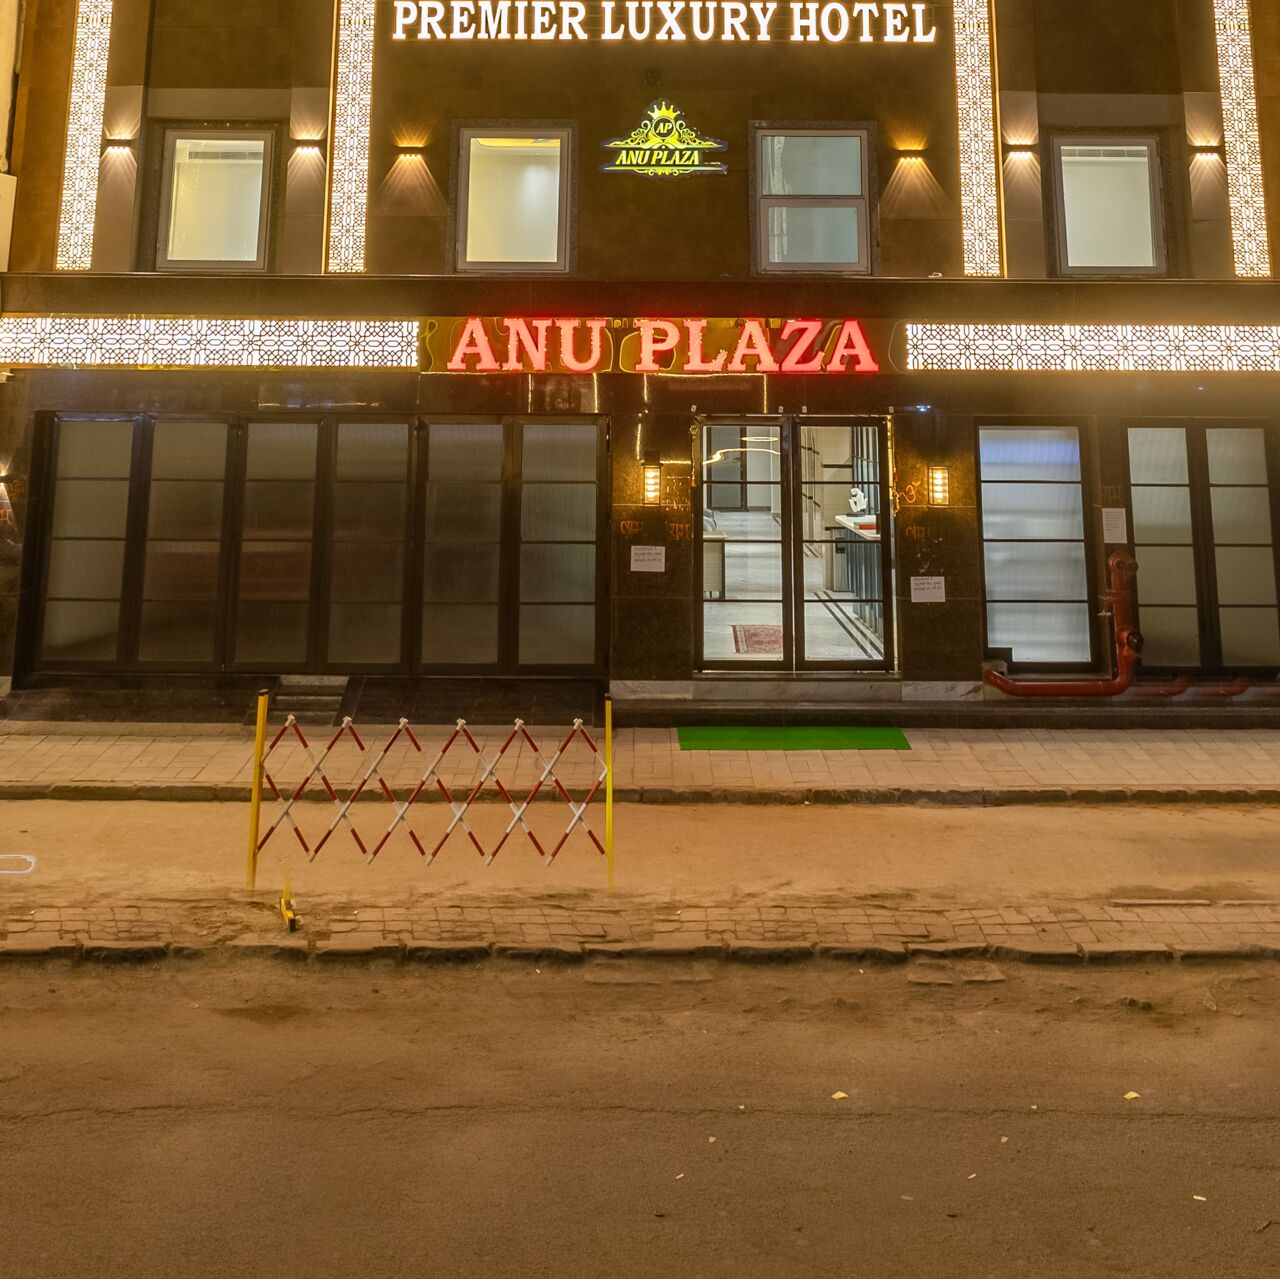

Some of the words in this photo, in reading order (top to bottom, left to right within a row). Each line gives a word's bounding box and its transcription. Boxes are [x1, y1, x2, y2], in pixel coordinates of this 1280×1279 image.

[392, 0, 589, 41] PREMIER
[601, 1, 778, 41] LUXURY
[790, 2, 936, 43] HOTEL
[656, 122, 673, 134] AP
[615, 150, 650, 165] ANU
[650, 150, 699, 165] PLAZA
[446, 317, 607, 373] ANU
[635, 317, 880, 373] PLAZA
